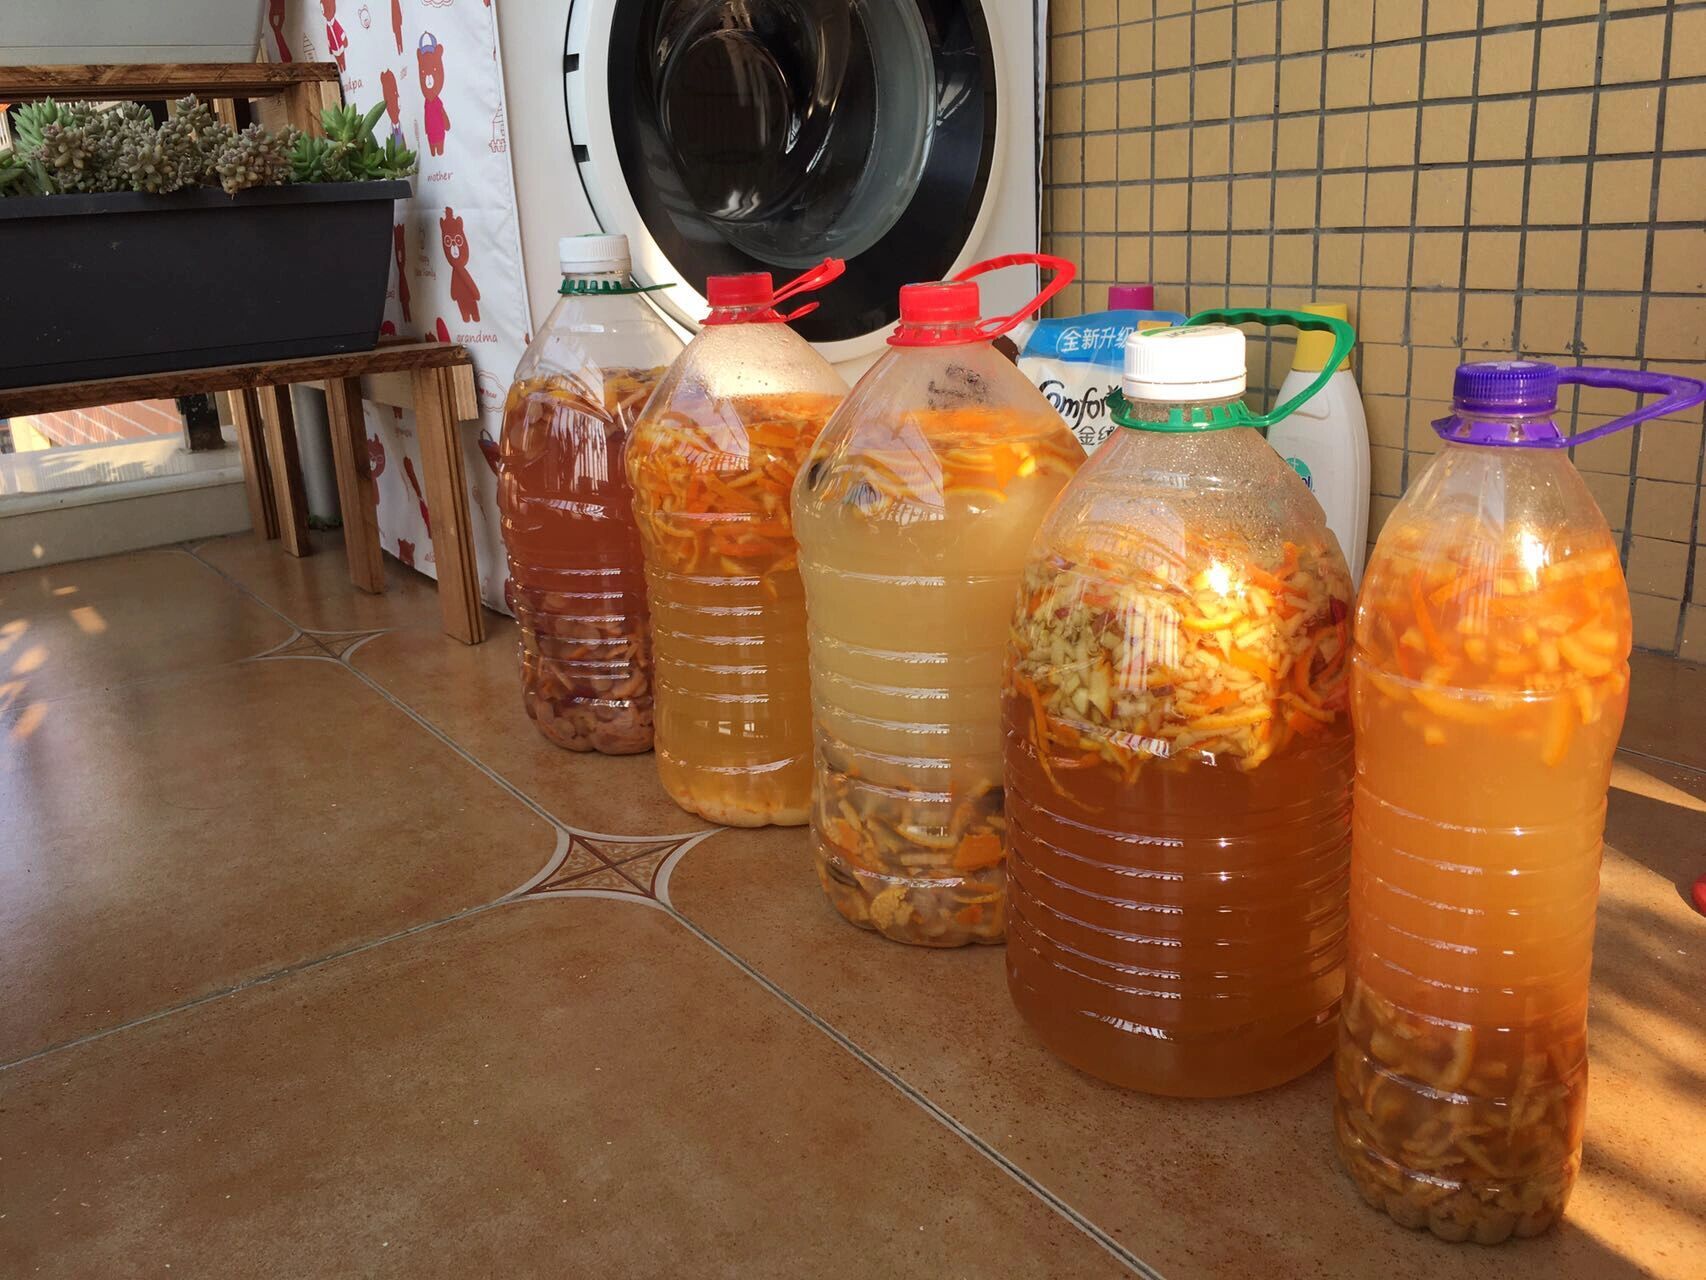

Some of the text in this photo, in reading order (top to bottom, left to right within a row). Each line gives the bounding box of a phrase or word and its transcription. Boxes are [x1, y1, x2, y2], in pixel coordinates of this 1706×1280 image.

[427, 171, 453, 182] mother
[456, 330, 498, 343] grandma
[1060, 326, 1136, 353] 全新升级
[1038, 379, 1119, 431] Comfor
